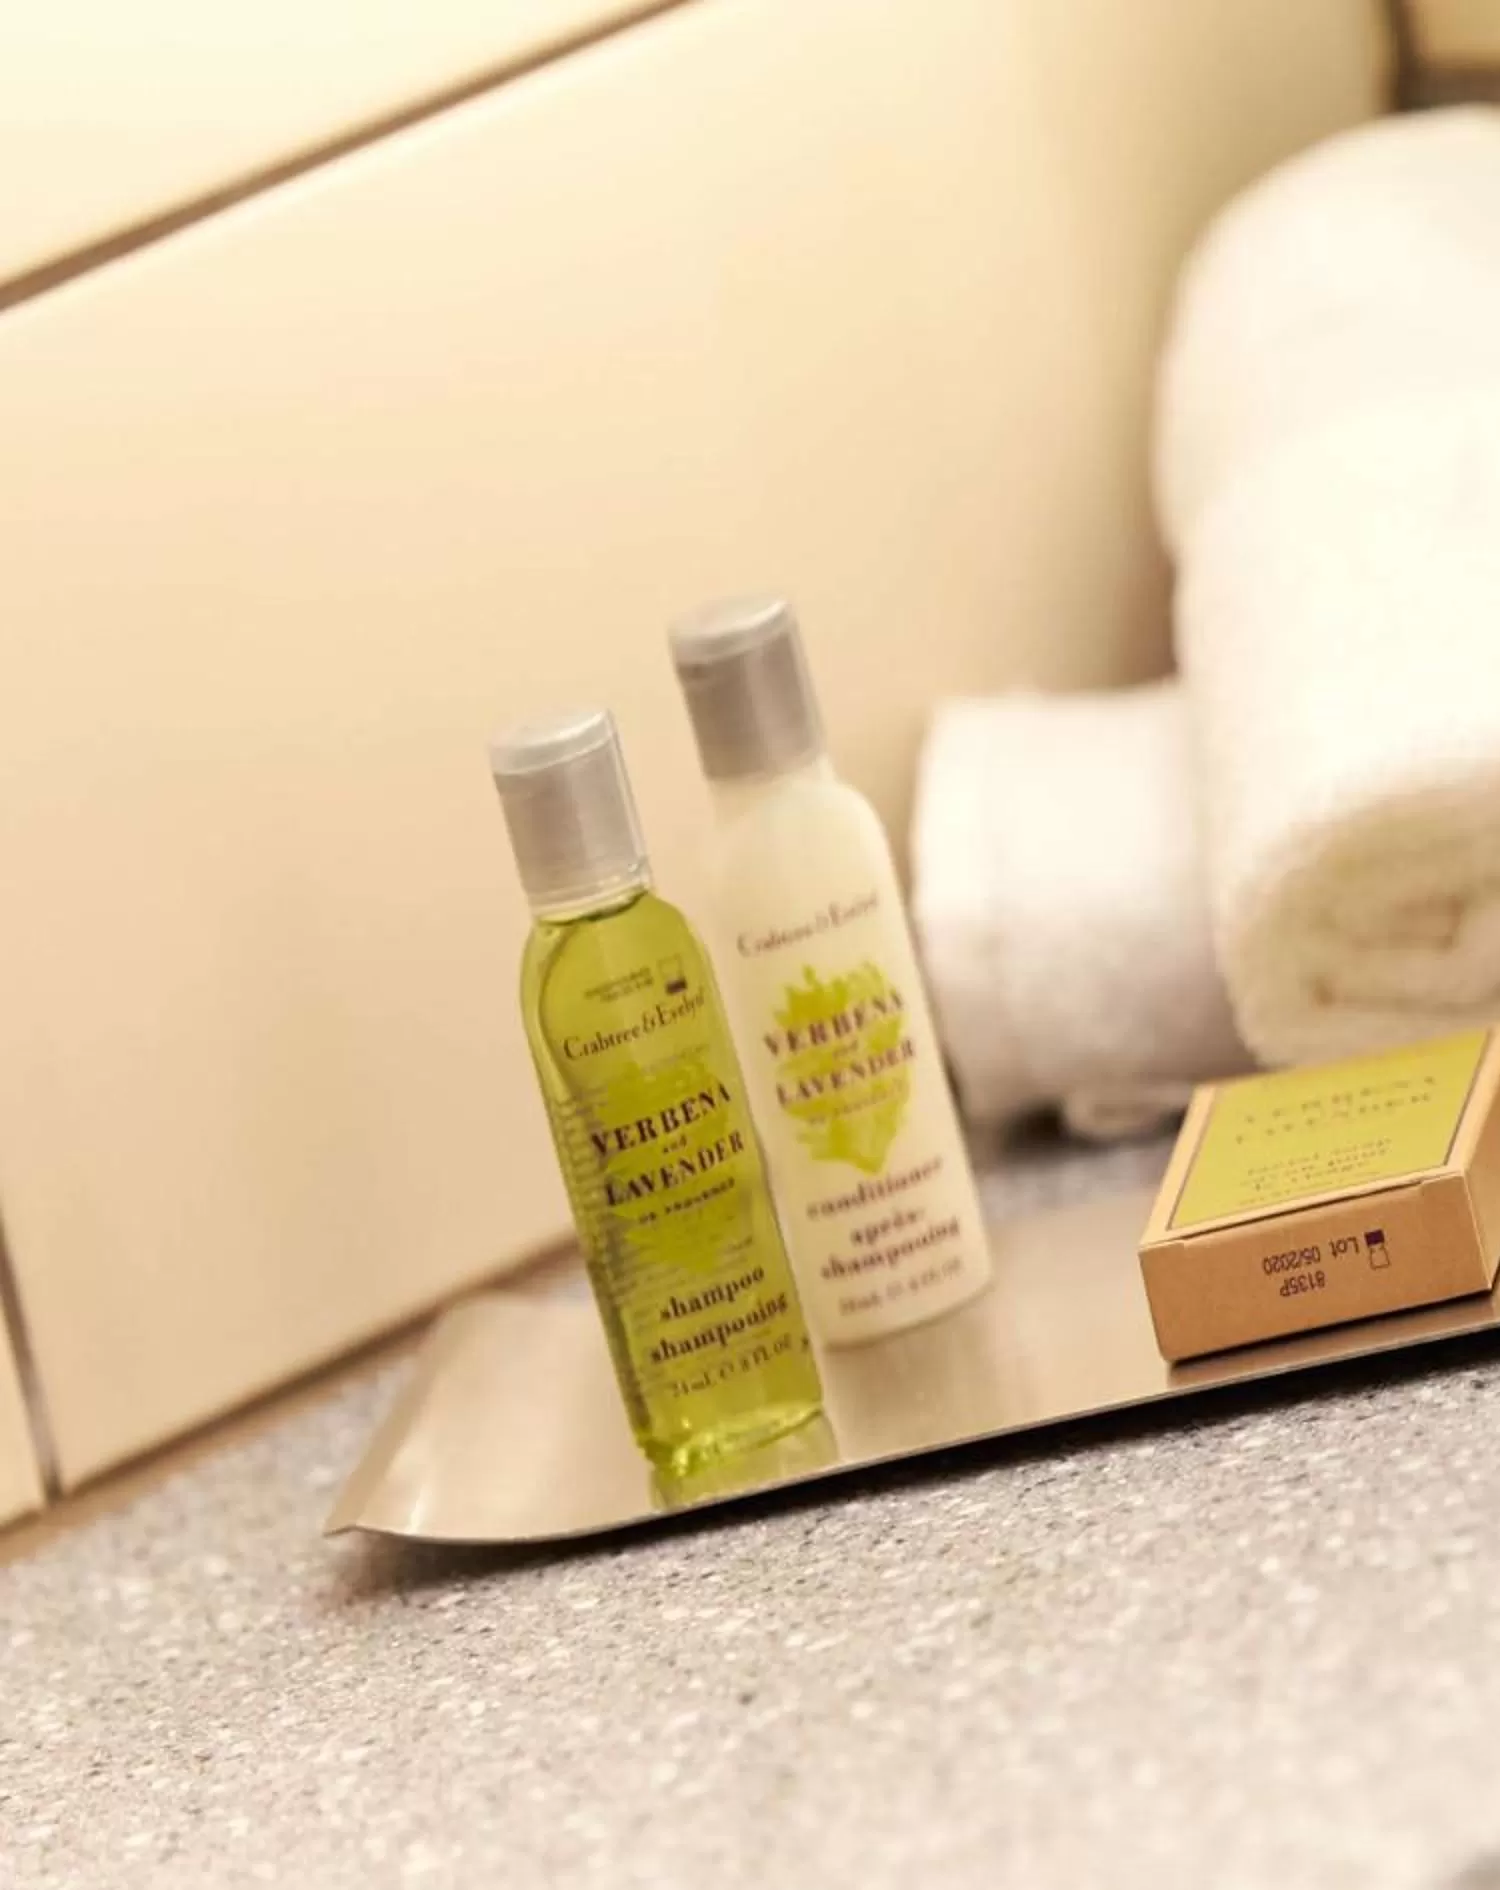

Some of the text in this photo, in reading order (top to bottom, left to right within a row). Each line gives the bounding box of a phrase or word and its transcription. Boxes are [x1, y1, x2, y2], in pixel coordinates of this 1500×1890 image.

[590, 1083, 732, 1158] VERBENA
[603, 1131, 745, 1207] LAVENDER
[1261, 1237, 1360, 1276] Lot 05/2020
[1279, 1271, 1327, 1298] 8135P
[659, 1265, 765, 1323] shampoo
